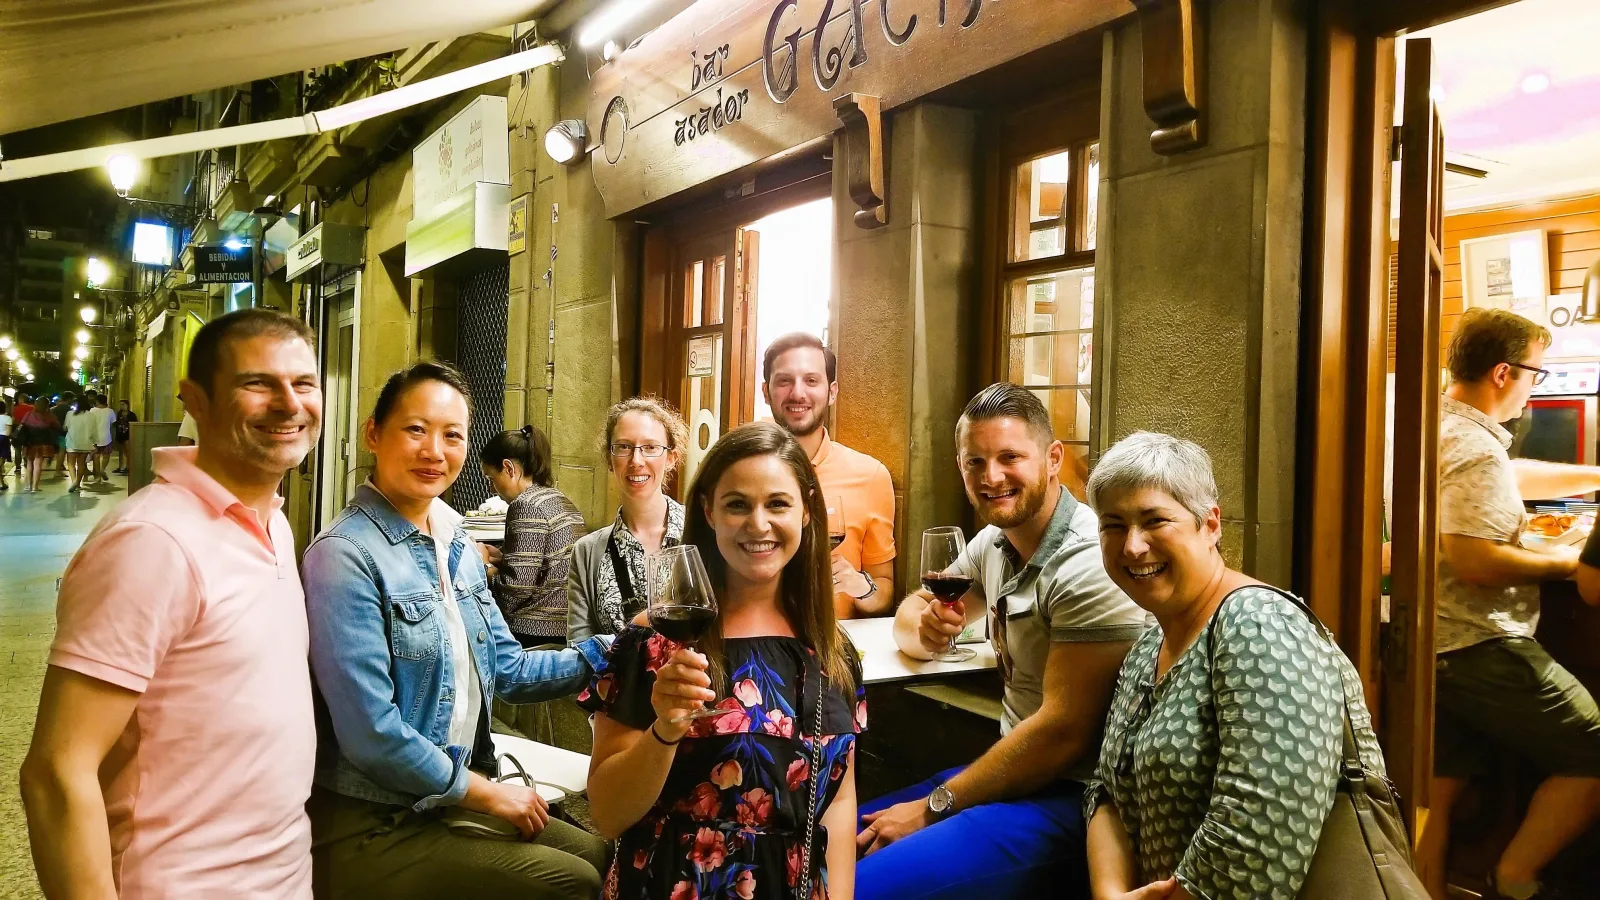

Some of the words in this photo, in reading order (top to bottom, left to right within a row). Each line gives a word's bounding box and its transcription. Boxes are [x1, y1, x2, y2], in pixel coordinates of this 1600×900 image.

[690, 42, 730, 91] bar
[673, 86, 750, 147] asador
[208, 252, 237, 262] BEBIDAS
[220, 262, 227, 271] Y
[198, 272, 250, 281] ALIMENTACION
